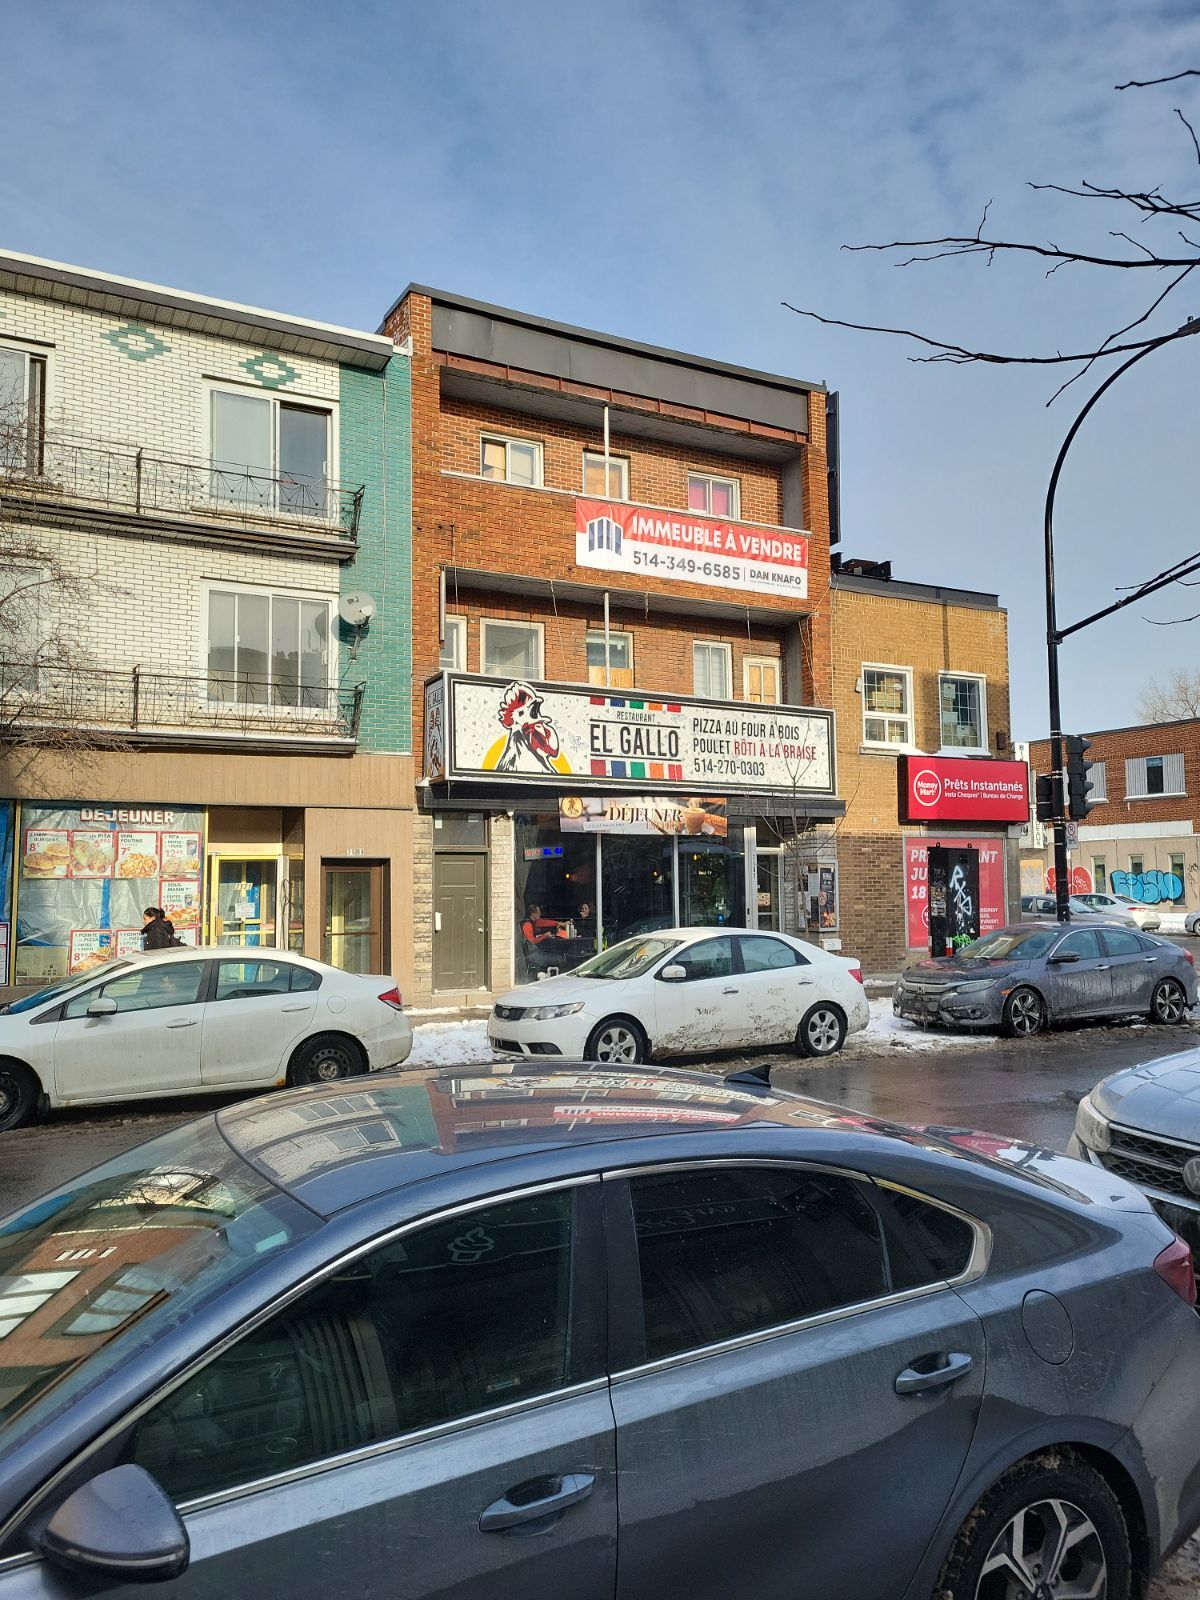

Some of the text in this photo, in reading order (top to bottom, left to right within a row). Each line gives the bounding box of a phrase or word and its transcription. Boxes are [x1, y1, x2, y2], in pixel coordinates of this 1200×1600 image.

[632, 515, 802, 562] IMMEUBLE À VENDRE
[633, 551, 740, 580] 514-349-6585
[750, 569, 769, 581] DAN
[771, 573, 801, 585] KNAFO
[616, 710, 656, 723] RESTAURANT
[693, 717, 799, 740] PIZZA AU FOUR À BOIS
[590, 723, 679, 757] EL GALLO
[693, 738, 817, 760] POULET RÔTI À LA BRAISE
[694, 758, 765, 776] 514-270-0303
[917, 781, 938, 790] Money
[944, 778, 1023, 792] Prêts Instantanés
[911, 849, 929, 863] PR
[911, 867, 928, 880] JU
